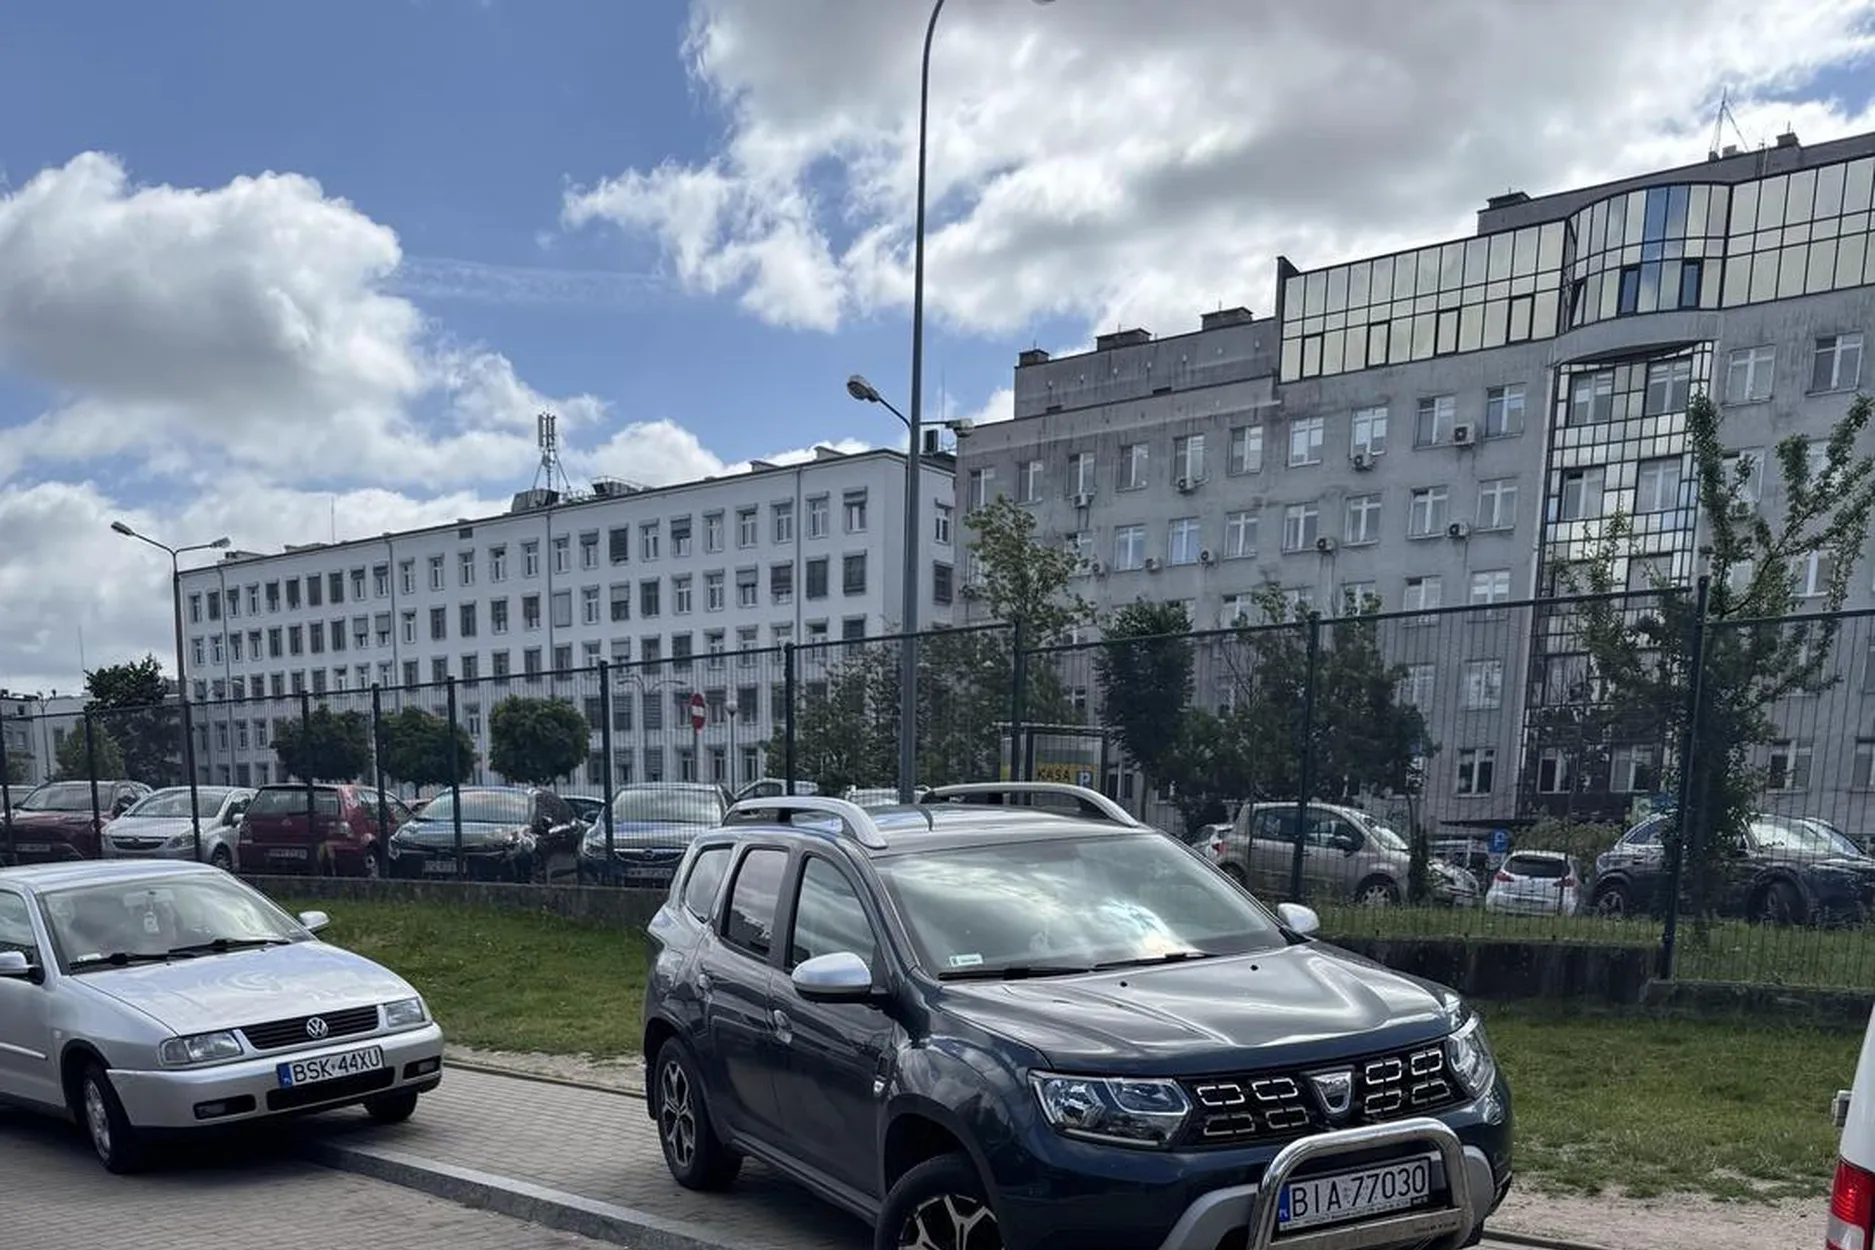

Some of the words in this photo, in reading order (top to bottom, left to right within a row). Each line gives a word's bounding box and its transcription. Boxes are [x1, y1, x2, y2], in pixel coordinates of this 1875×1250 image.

[1037, 768, 1071, 780] KASA
[292, 1059, 333, 1082] BSK
[338, 1049, 380, 1073] 44XU
[1291, 1181, 1342, 1217] BIA
[1351, 1165, 1426, 1207] 77030
